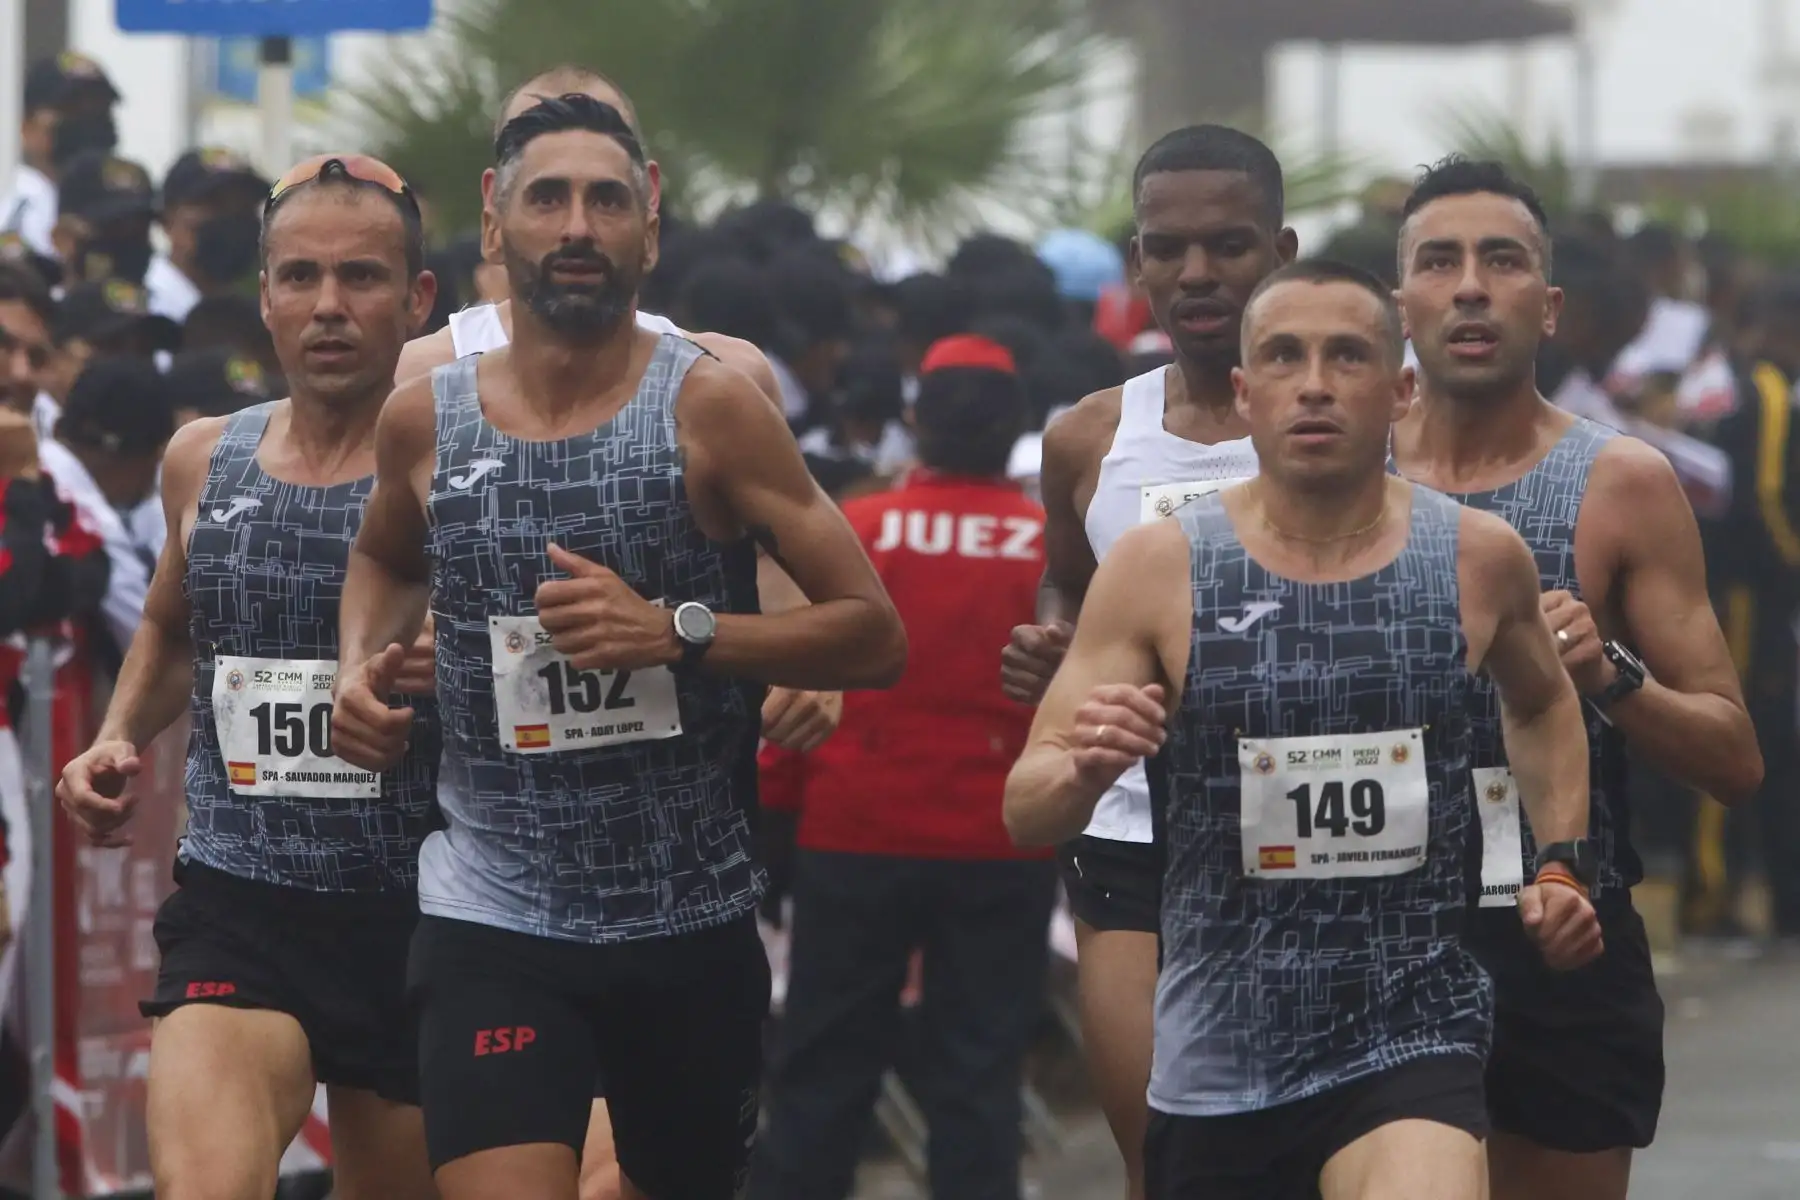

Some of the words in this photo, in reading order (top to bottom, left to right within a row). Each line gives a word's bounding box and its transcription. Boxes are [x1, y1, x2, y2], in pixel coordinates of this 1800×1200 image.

[873, 509, 1041, 560] JUEZ
[277, 672, 303, 681] CMM
[313, 682, 333, 690] 202
[538, 660, 635, 714] 152
[249, 702, 334, 757] 150
[564, 728, 583, 739] SPA
[591, 725, 614, 736] ADAY
[616, 721, 644, 734] LOPEZ
[1312, 748, 1342, 760] CMM
[262, 771, 278, 781] SPA
[285, 772, 331, 783] SALVADOR
[333, 773, 377, 784] MARQUEZ
[1286, 779, 1386, 838] 149
[1310, 852, 1330, 864] SPA
[1336, 851, 1369, 863] JAVIER
[185, 981, 236, 999] ESP
[474, 1026, 537, 1057] ESP
